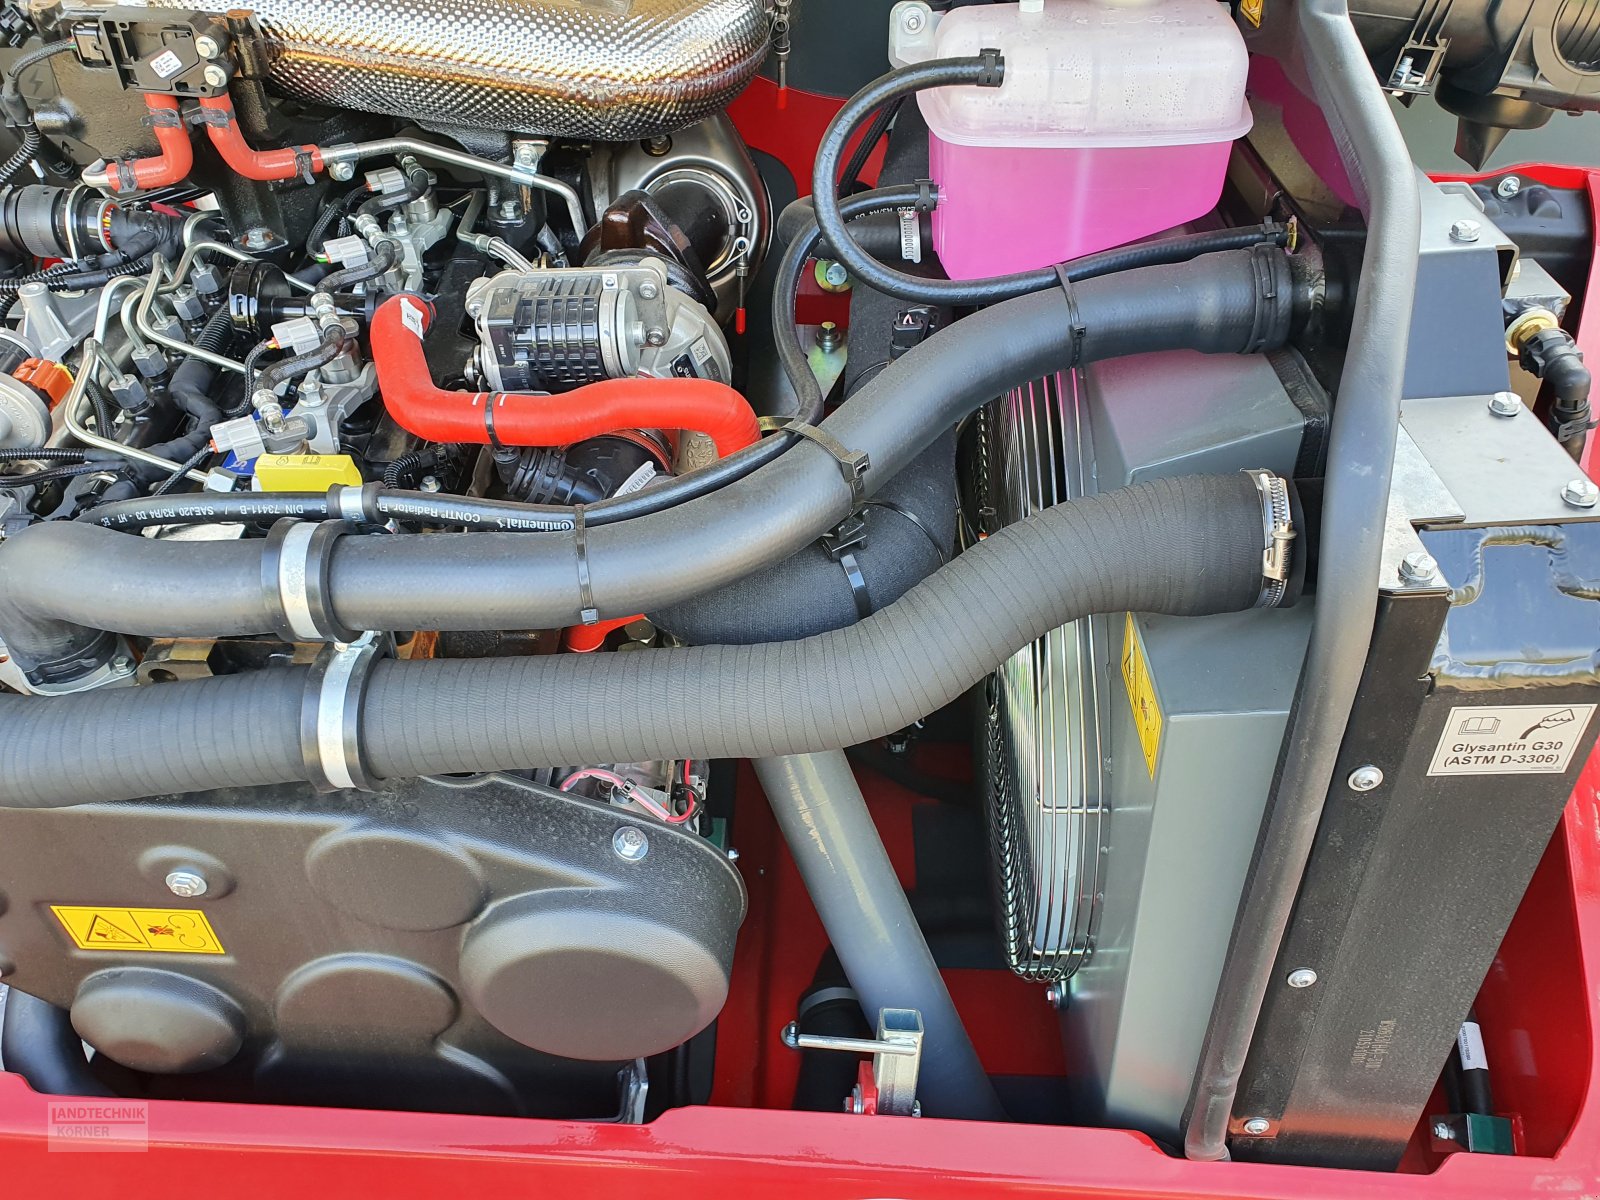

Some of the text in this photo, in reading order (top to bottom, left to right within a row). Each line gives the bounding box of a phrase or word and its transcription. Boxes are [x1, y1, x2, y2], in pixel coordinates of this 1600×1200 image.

[135, 509, 146, 521] D3
[149, 507, 175, 518] R3/R4
[179, 505, 214, 517] SAEJ20
[239, 504, 280, 515] 73411-B
[286, 504, 303, 514] DIN
[394, 503, 438, 517] Radiator
[117, 512, 127, 524] HT
[506, 517, 575, 531] Continental
[1452, 741, 1563, 754] Glysantin G30
[1444, 754, 1560, 767] (ASTM D-3306)
